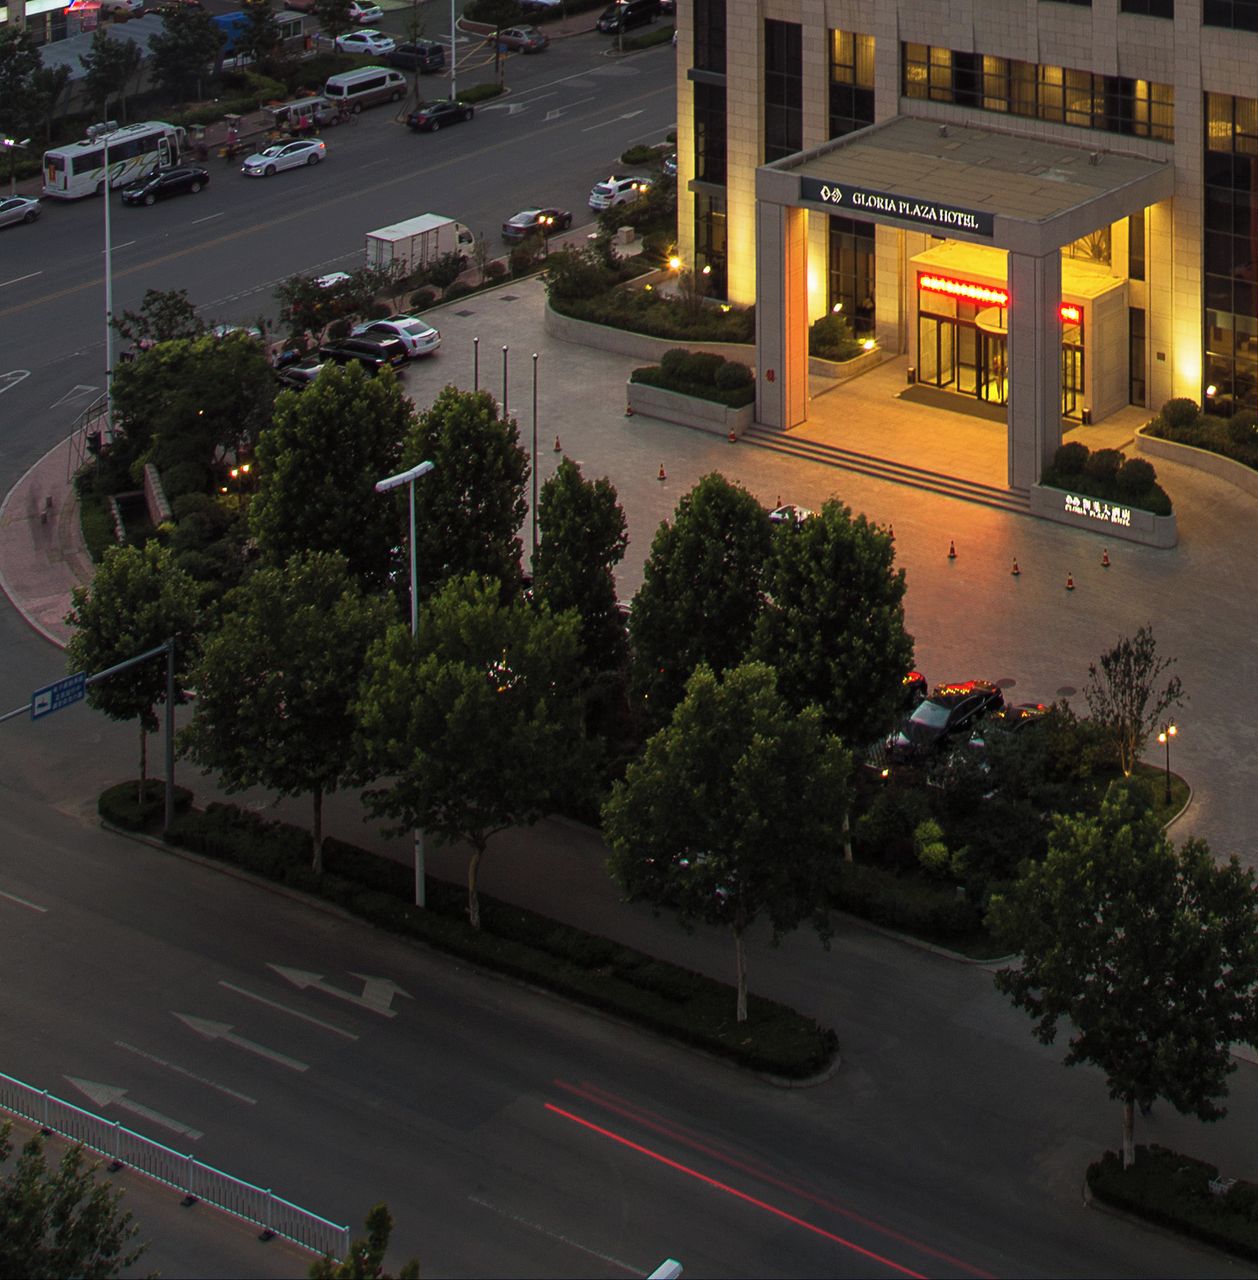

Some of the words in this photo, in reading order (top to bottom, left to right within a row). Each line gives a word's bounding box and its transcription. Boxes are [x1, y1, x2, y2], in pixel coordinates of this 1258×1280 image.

[852, 192, 897, 212] GLORIA
[899, 200, 937, 221] PLAZA
[940, 208, 979, 229] HOTEL
